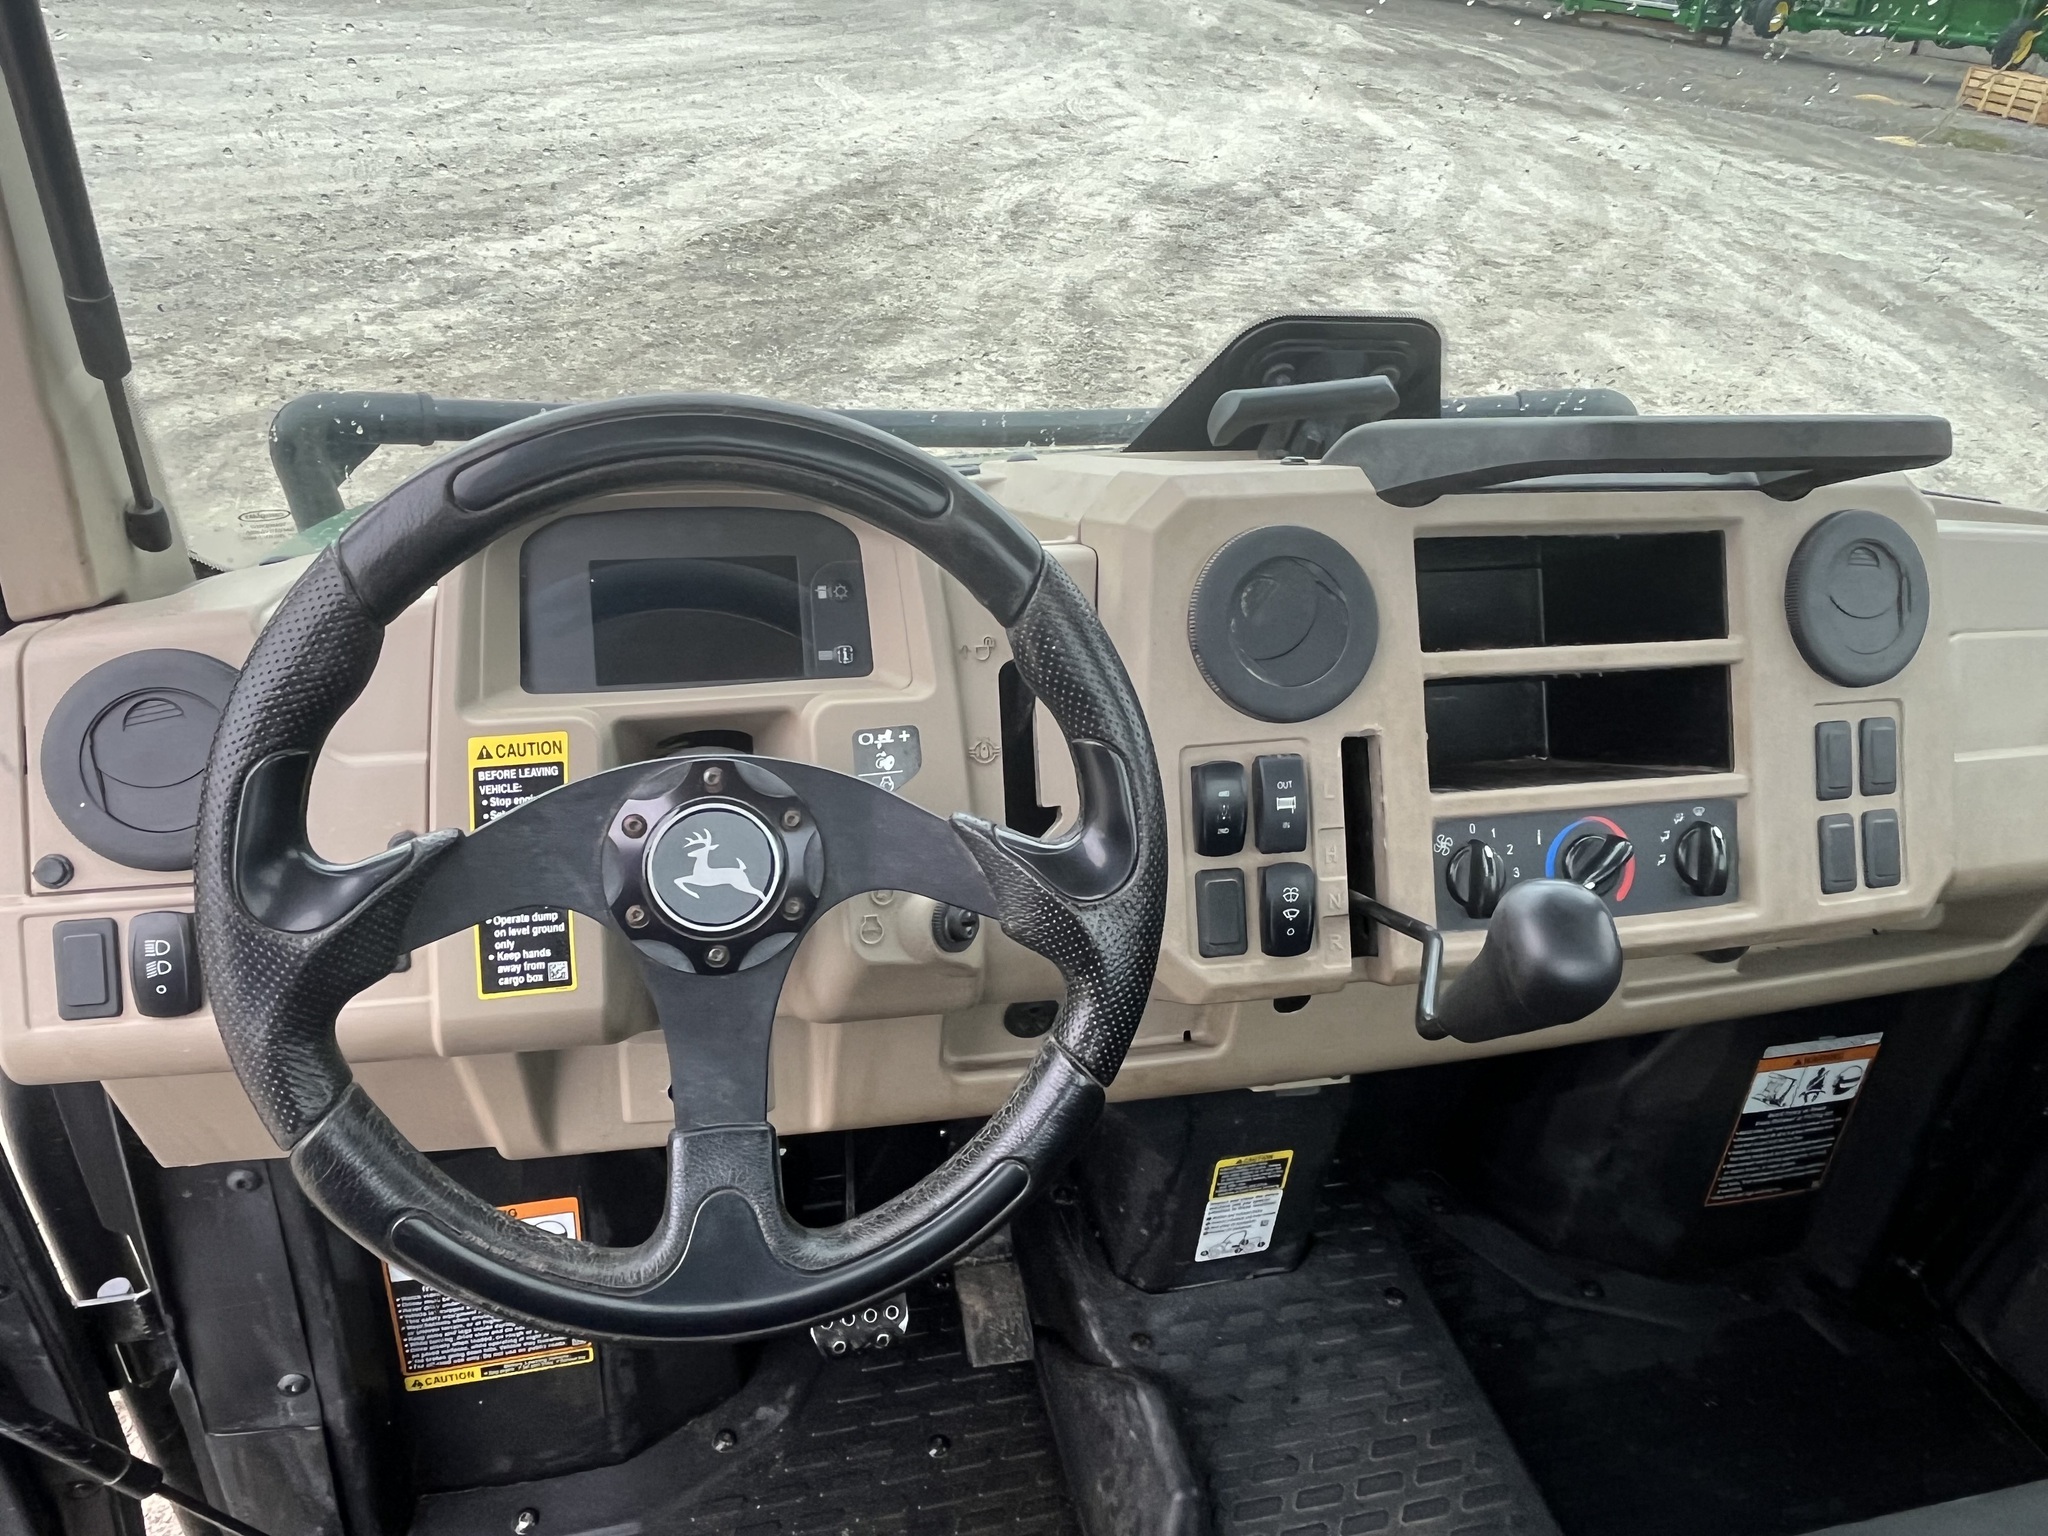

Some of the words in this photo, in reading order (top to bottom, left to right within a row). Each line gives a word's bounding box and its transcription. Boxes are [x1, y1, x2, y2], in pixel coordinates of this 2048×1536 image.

[496, 740, 562, 758] CAUTION
[478, 769, 516, 781] BEFORE
[519, 766, 558, 778] LEAVING
[479, 783, 522, 795] VEHICLE:
[1276, 779, 1293, 790] OUT
[489, 797, 512, 808] Stop
[1506, 843, 1514, 855] 2
[1513, 866, 1520, 878] 3
[493, 914, 530, 927] Operate
[531, 912, 558, 922] dump
[494, 929, 506, 938] on
[508, 925, 530, 936] level
[532, 922, 565, 936] ground
[494, 939, 515, 950] only
[496, 952, 521, 961] Keep
[523, 948, 551, 959] hands
[497, 964, 522, 974] away
[523, 961, 546, 971] from
[498, 976, 525, 987] cargo
[526, 974, 544, 983] box
[425, 1371, 475, 1386] CAUTION
